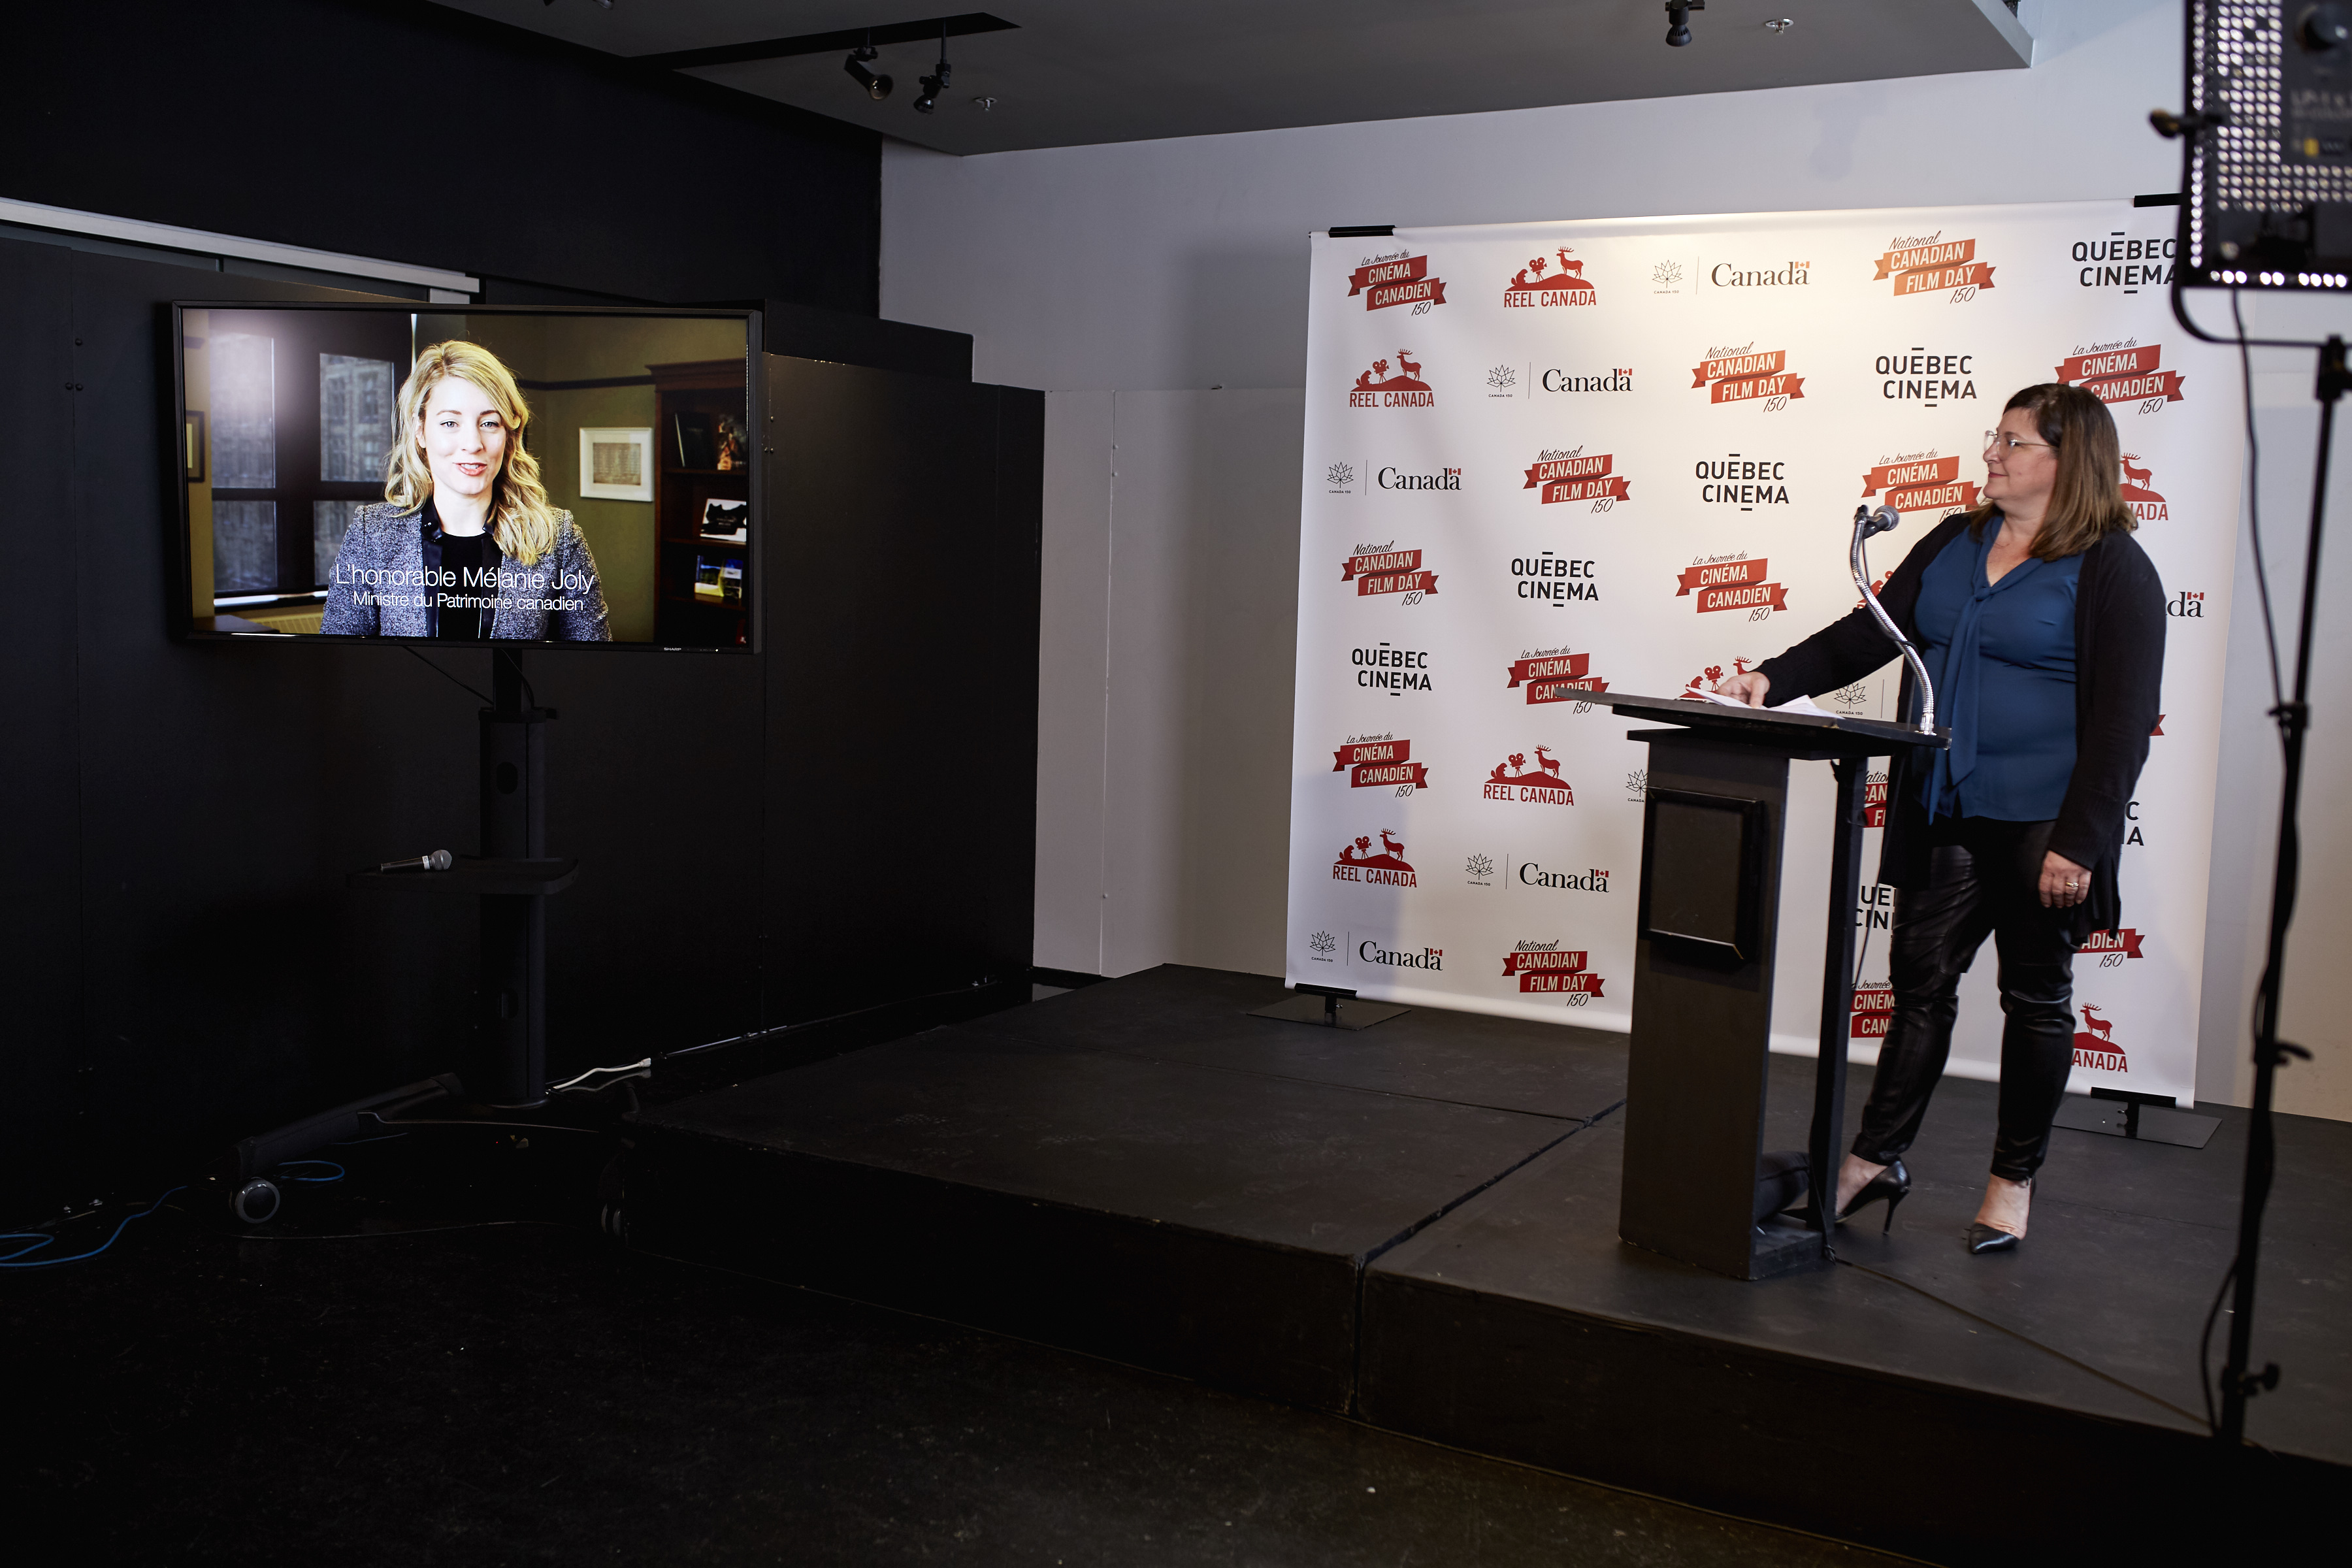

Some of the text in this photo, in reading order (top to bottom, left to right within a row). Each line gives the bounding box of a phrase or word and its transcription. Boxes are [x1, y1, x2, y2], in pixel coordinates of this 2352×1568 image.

[1889, 230, 1941, 250] National
[1362, 249, 1409, 266] La Journée du
[1891, 242, 1965, 269] CANADIAN
[1369, 263, 1411, 284] CINÉMA
[1711, 261, 1810, 286] Canada
[1906, 266, 1976, 293] FILM DAY
[1375, 282, 1431, 305] CANADIEN
[1504, 290, 1597, 308] REEL CANADA
[1950, 287, 1975, 304] 150
[1411, 302, 1431, 316] 150
[1705, 341, 1754, 359] National
[2073, 336, 2137, 355] La Journée du
[1708, 353, 1776, 378] CANADIAN
[2082, 353, 2137, 376] CINÉMA
[1542, 368, 1633, 392] Canada
[1722, 376, 1786, 401] FILM DAY
[1349, 392, 1435, 408] REEL CANADA
[1763, 397, 1787, 413] 150
[2138, 398, 2163, 415] 150
[1537, 445, 1583, 462] National
[1879, 448, 1938, 465] La Journée du
[1539, 457, 1603, 480] CANADIAN
[1887, 463, 1938, 485] CINÉMA
[1378, 467, 1462, 491] Canada
[1552, 480, 1613, 502] FILM DAY
[1895, 486, 1963, 510] CANADIEN
[1591, 498, 1614, 514] 150
[1353, 540, 1394, 555] National
[1355, 552, 1413, 572] CANADIAN
[1693, 550, 1748, 565] La Journée du
[336, 564, 594, 594] L'honorable Mélanie Joly
[1367, 574, 1422, 593] FILM DAY
[1701, 564, 1748, 585] CINÉMA
[353, 591, 583, 611] Ministre du Patrimoine canadien
[1402, 592, 1423, 606] 150
[1707, 587, 1771, 608] CANADIEN
[1749, 608, 1770, 622] 150
[1521, 645, 1571, 659] La Journée du
[1529, 659, 1571, 678] CINÉMA
[1573, 702, 1592, 714] 150
[1347, 732, 1393, 743] La Journée du
[1354, 743, 1394, 762] CINÉMA
[1360, 766, 1413, 783] CANADIEN
[1396, 785, 1413, 798] 150
[1484, 785, 1574, 806] REEL CANADA
[1333, 866, 1417, 888] REEL CANADA
[1520, 862, 1609, 892] Canada
[1515, 939, 1559, 951] National
[1359, 941, 1443, 971] Canada
[1517, 953, 1578, 968] CANADIAN
[2099, 954, 2123, 968] 150
[1530, 976, 1588, 991] FILM DAY
[1858, 979, 1890, 989] Journée
[1567, 994, 1588, 1007] 150
[1854, 991, 1895, 1009] CINÉM
[2071, 1050, 2128, 1072] ANADA
